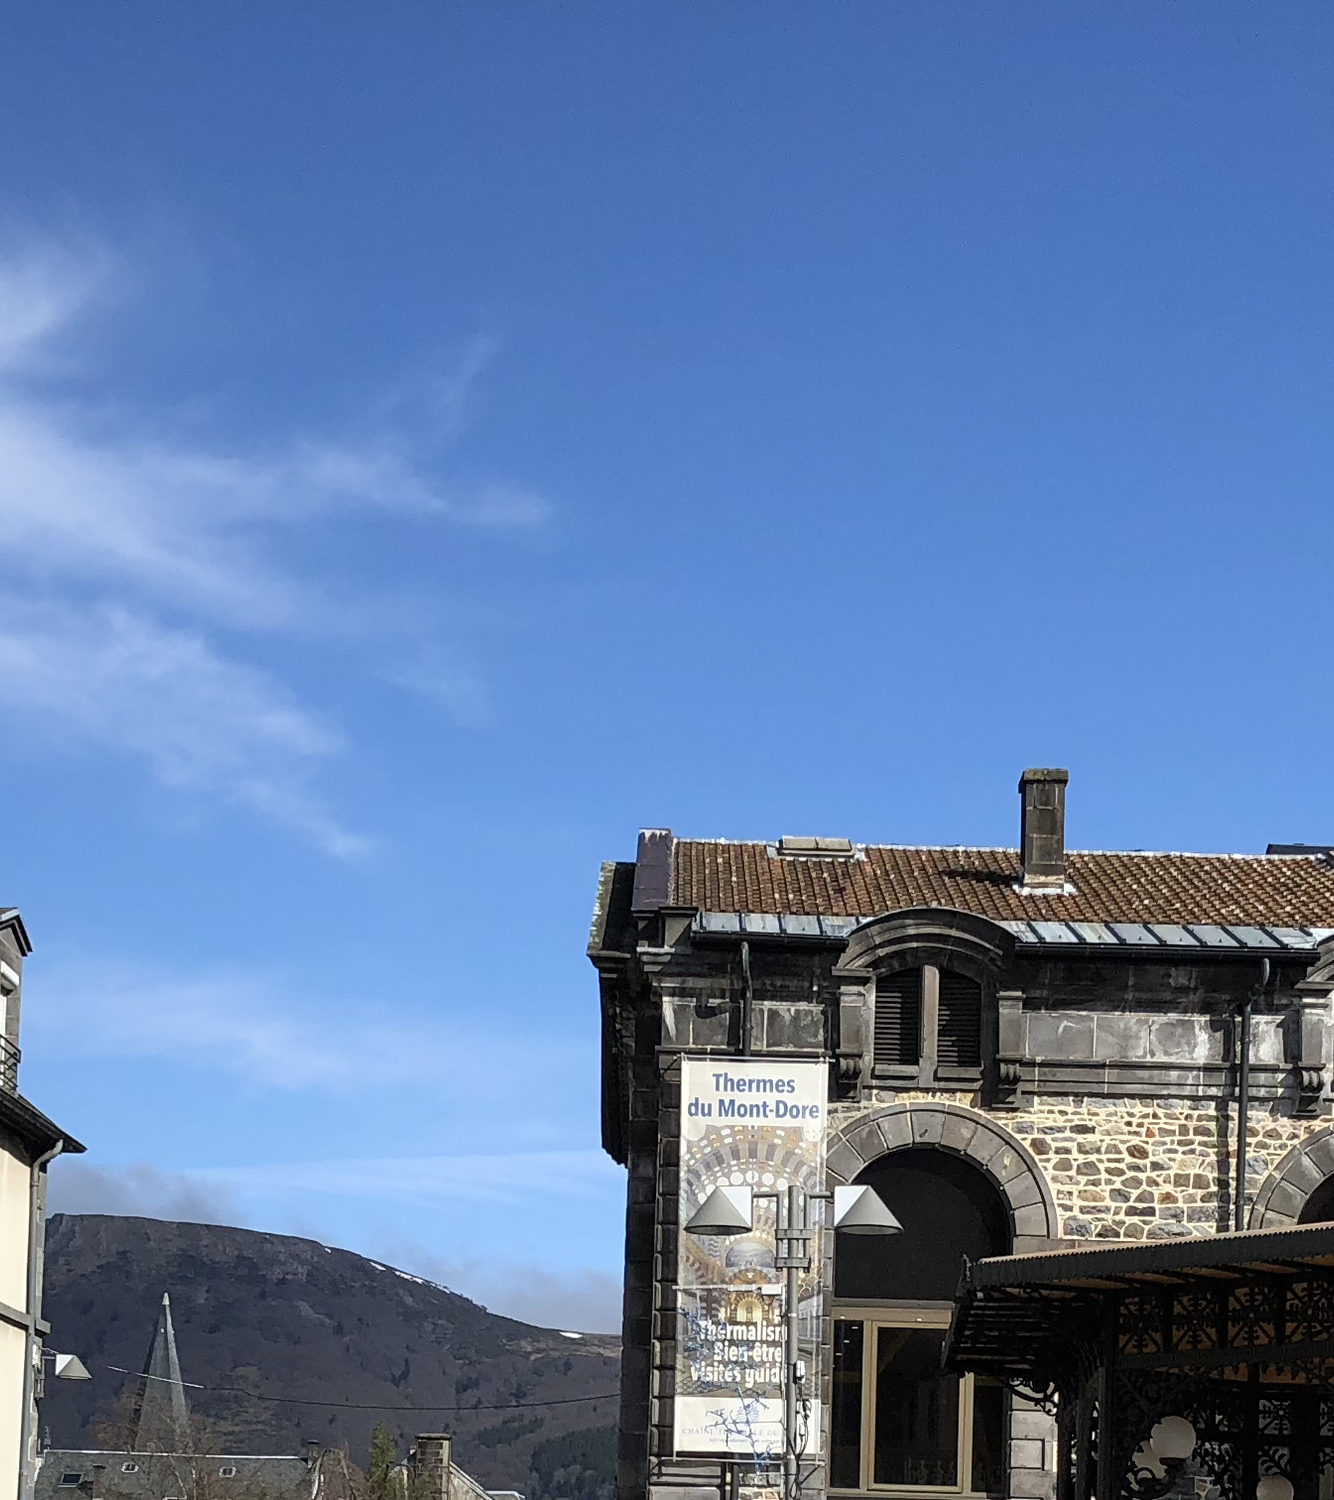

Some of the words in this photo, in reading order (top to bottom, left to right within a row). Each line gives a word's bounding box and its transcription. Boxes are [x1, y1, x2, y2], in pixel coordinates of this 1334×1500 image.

[712, 1072, 796, 1094] Thermes
[687, 1097, 713, 1118] du
[718, 1099, 820, 1119] Mont-Dore
[698, 1320, 788, 1342] Thermalis
